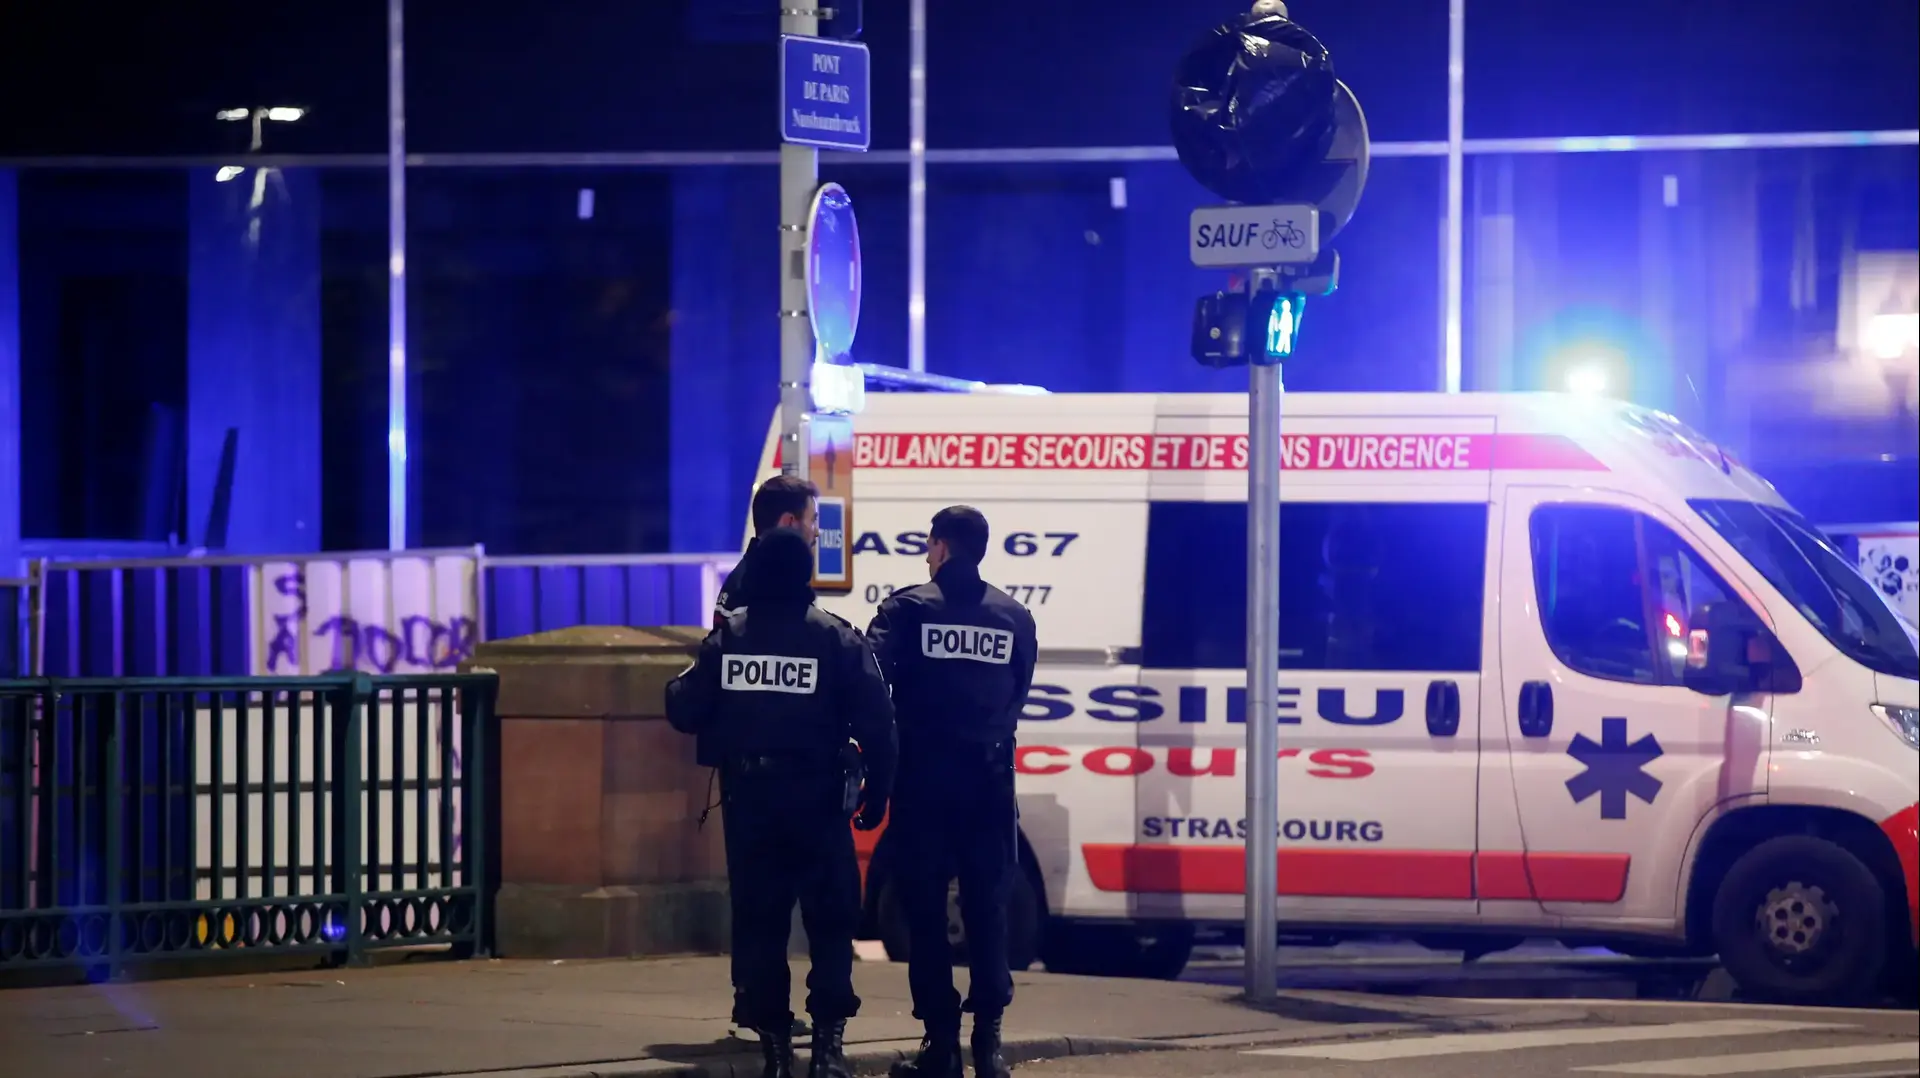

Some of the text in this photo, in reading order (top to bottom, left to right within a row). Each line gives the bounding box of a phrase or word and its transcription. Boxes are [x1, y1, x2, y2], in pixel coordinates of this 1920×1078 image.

[812, 53, 840, 74] PONT
[804, 81, 849, 104] DE PARIS
[1196, 223, 1259, 248] SAUF
[853, 435, 1471, 468] BULANCE DE SECOURS ET DE SNS D'URGENCE
[818, 528, 842, 549] TAXIS
[1003, 532, 1079, 556] 67
[927, 629, 1008, 659] POLICE
[727, 660, 812, 688] POLICE
[1018, 684, 1404, 725] SSIEU
[1014, 745, 1375, 778] cous
[1143, 816, 1384, 842] STRAOURG
